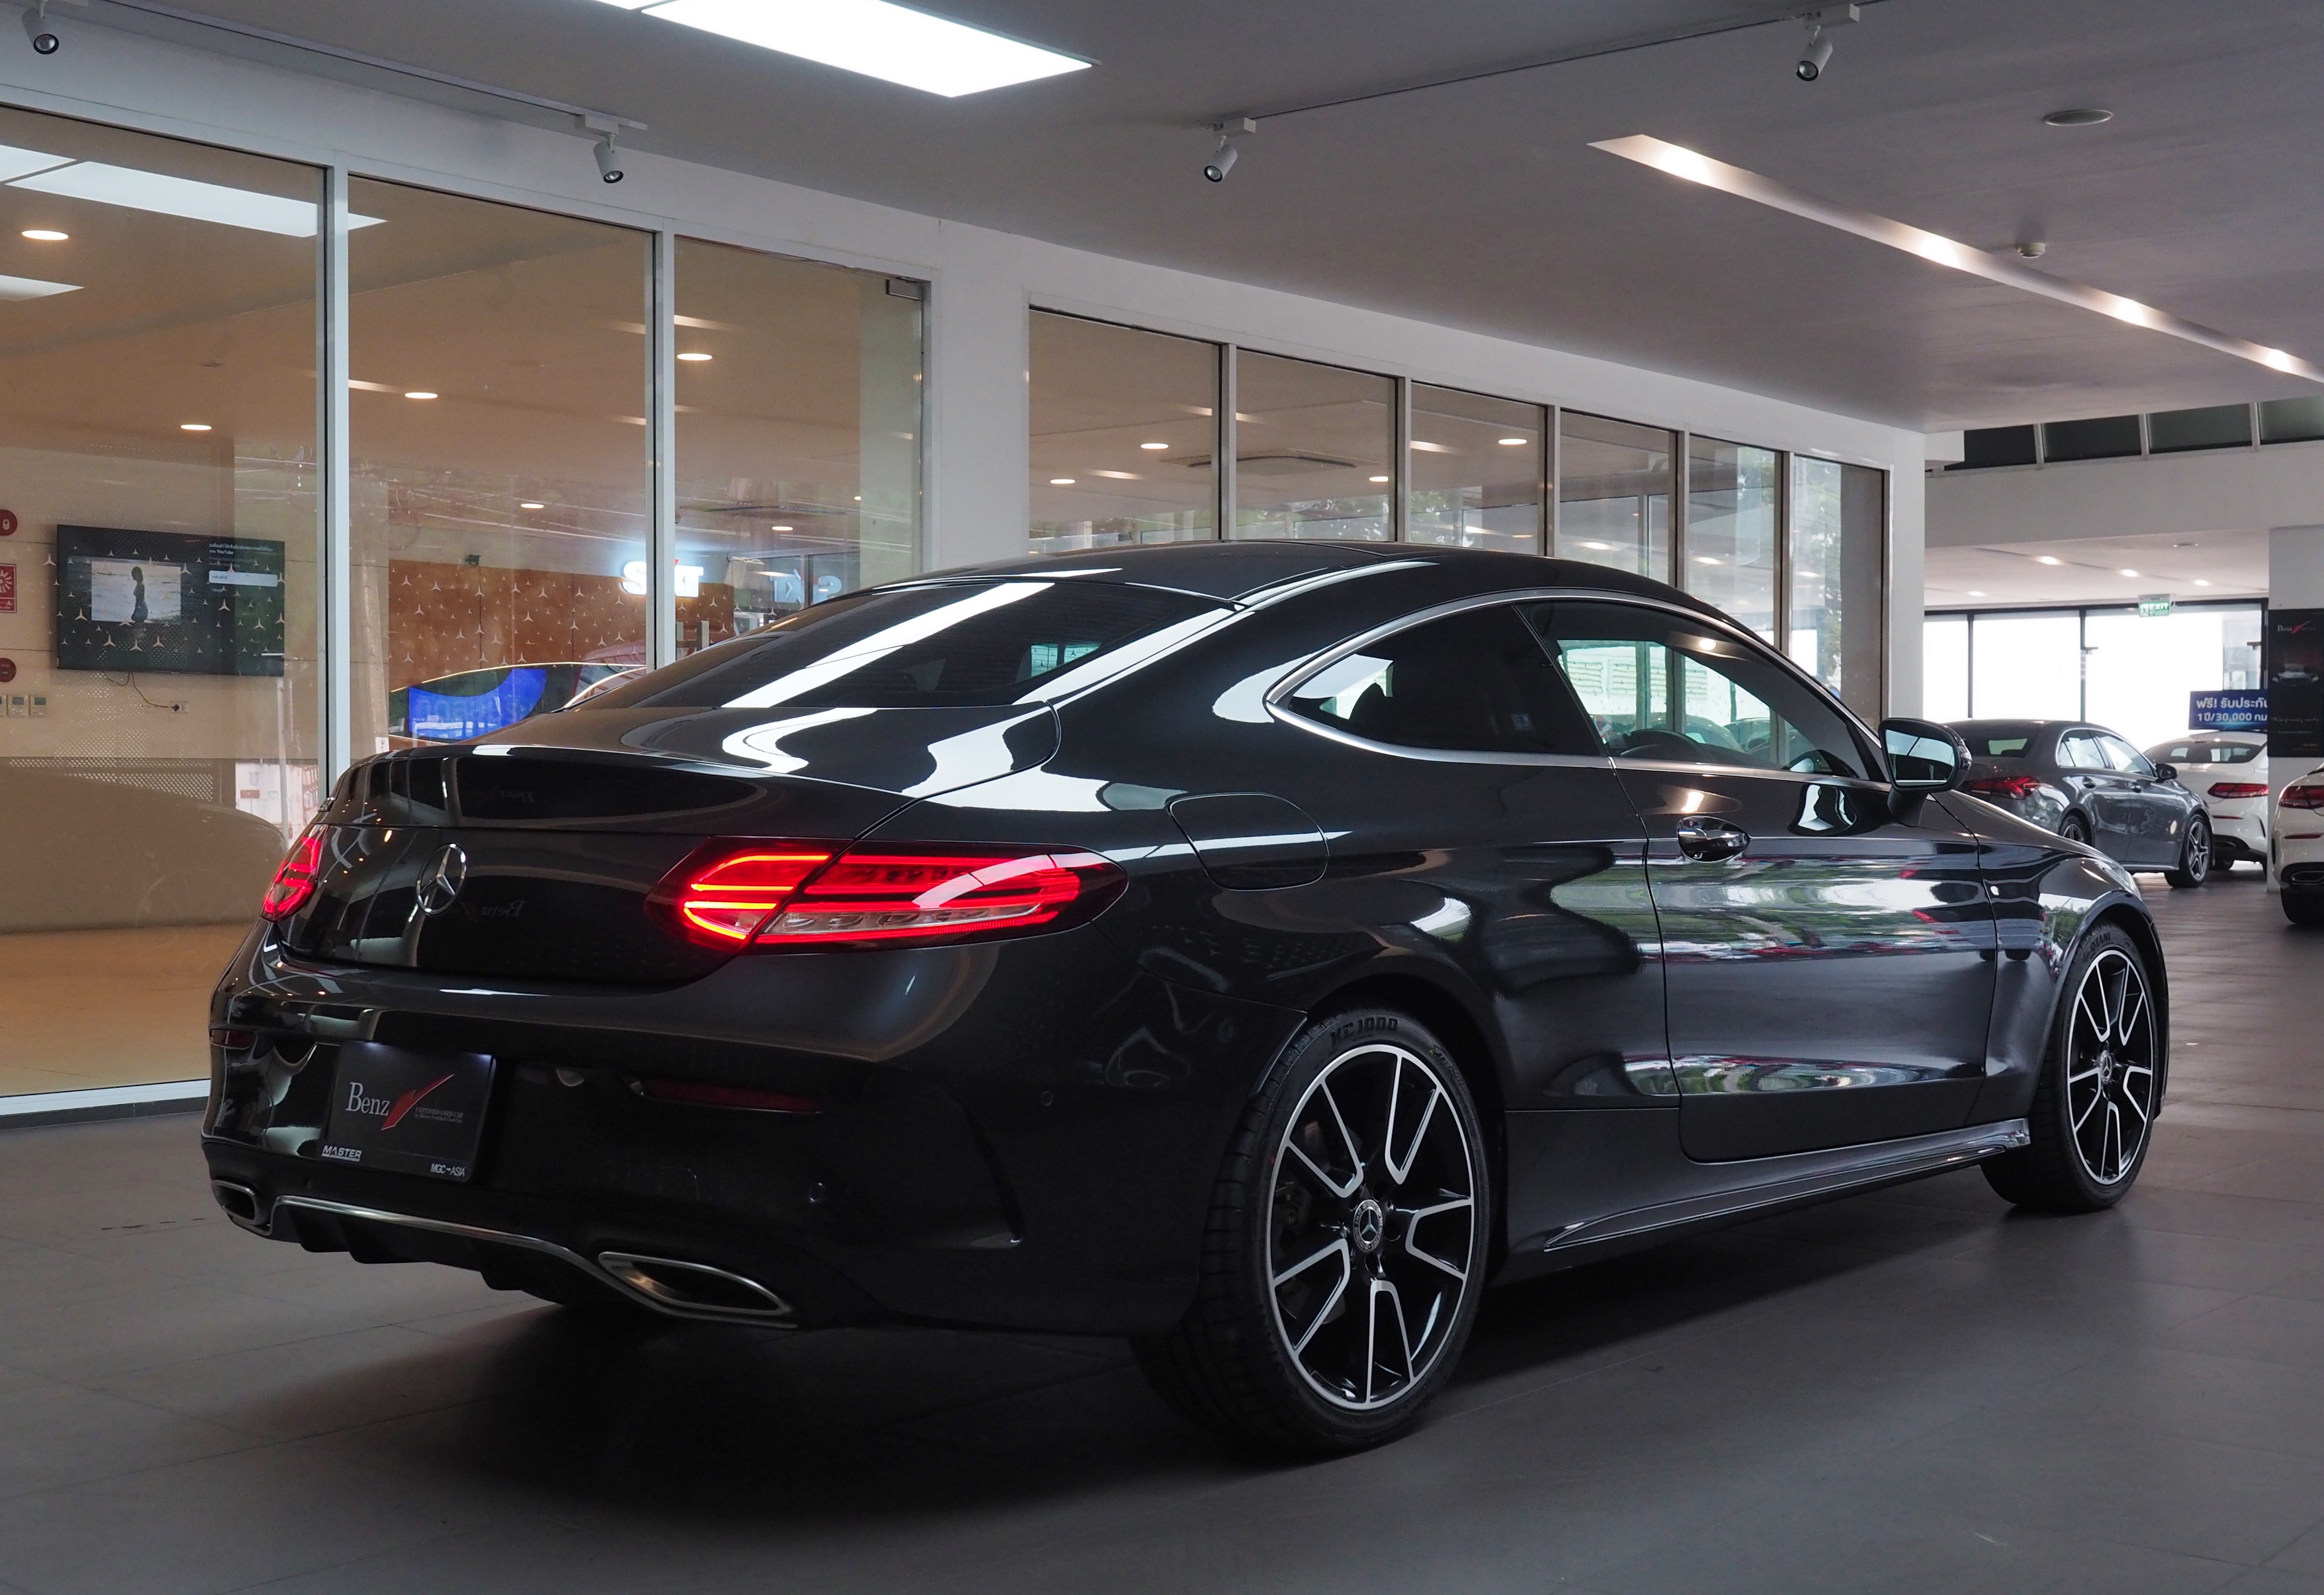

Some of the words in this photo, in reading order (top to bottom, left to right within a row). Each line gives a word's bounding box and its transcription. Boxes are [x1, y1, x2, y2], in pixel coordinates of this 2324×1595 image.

[2196, 697, 2217, 709] ฟรี!
[1358, 1017, 1398, 1033] 1000
[345, 1082, 390, 1116] Benz
[323, 1145, 362, 1159] MASTER
